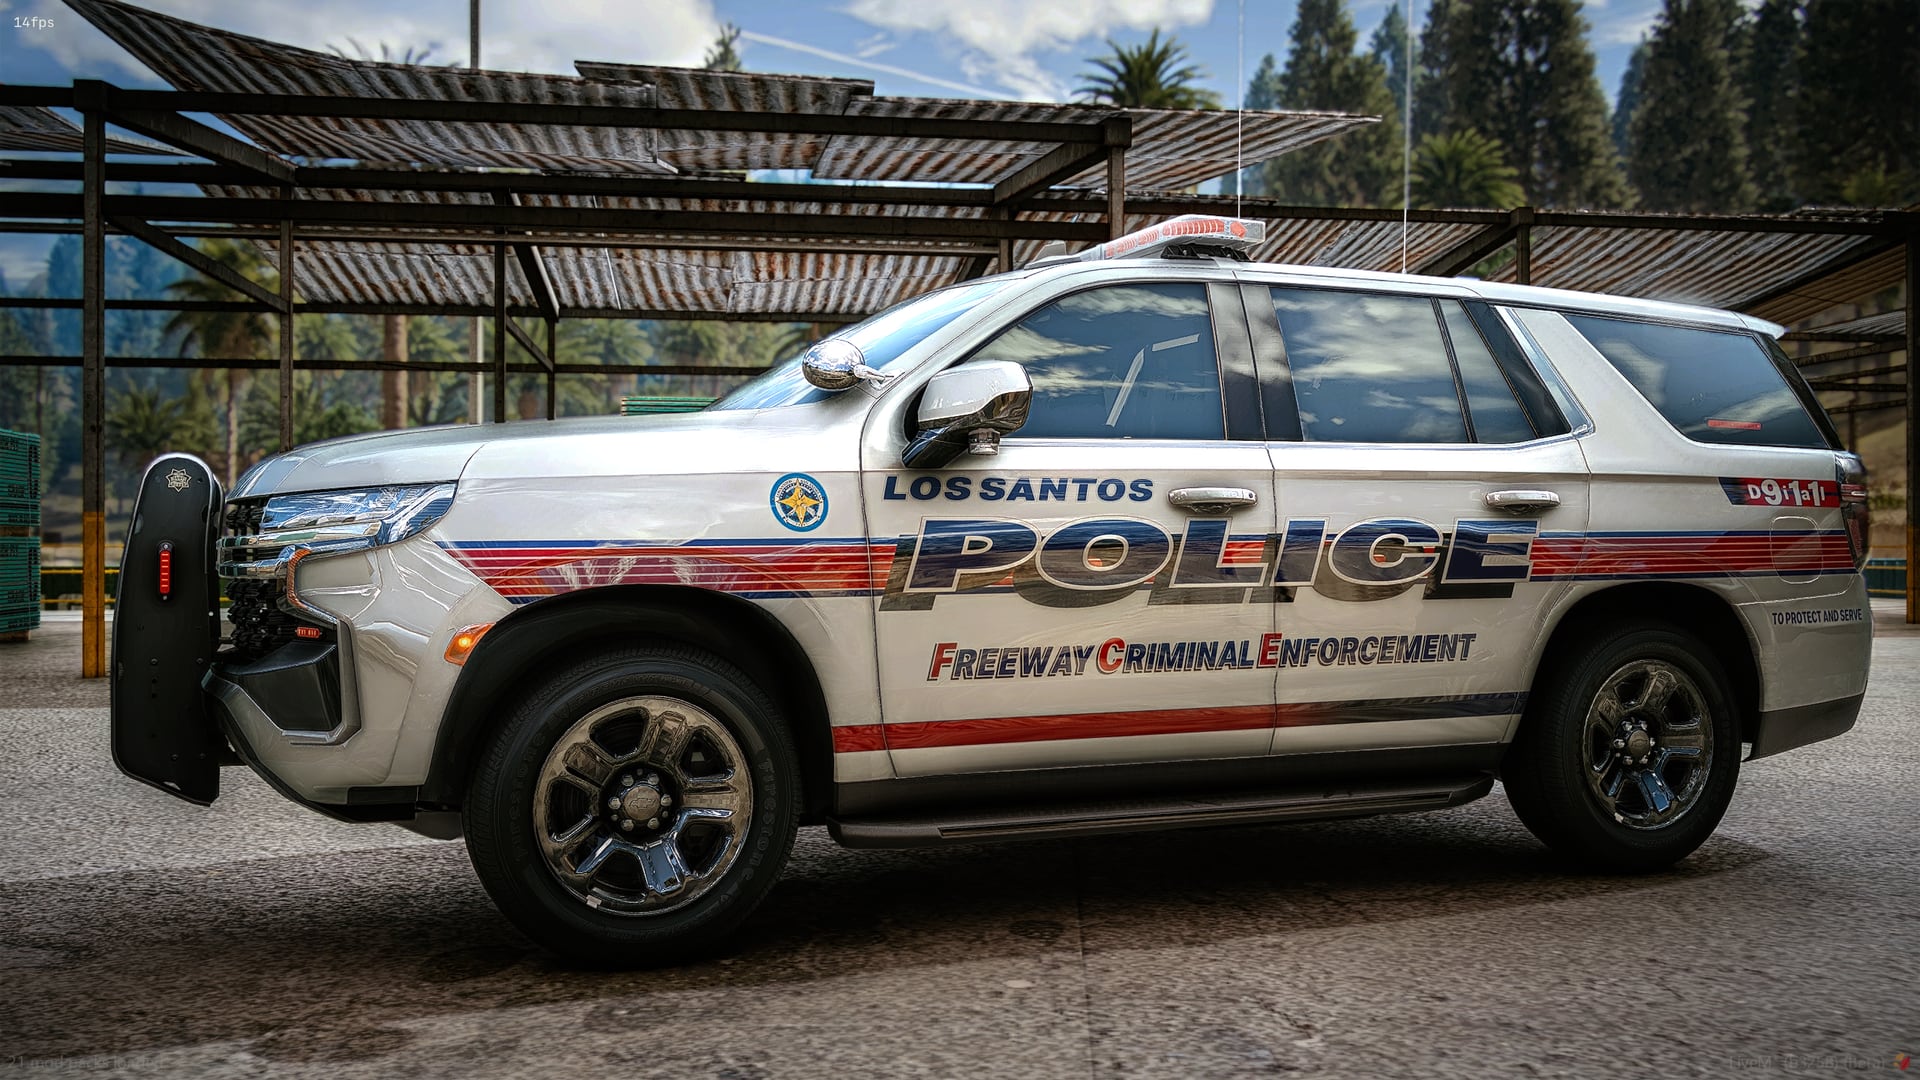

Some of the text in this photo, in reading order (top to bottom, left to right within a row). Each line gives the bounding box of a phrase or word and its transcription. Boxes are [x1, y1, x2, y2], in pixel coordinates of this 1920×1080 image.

[883, 476, 1154, 502] LOS SANTOS
[902, 514, 1542, 594] POLICE
[1772, 608, 1863, 625] TO PROTECT AND SERVE
[926, 633, 1477, 682] FREEWAY CRIMINAL ENFORCEMENT
